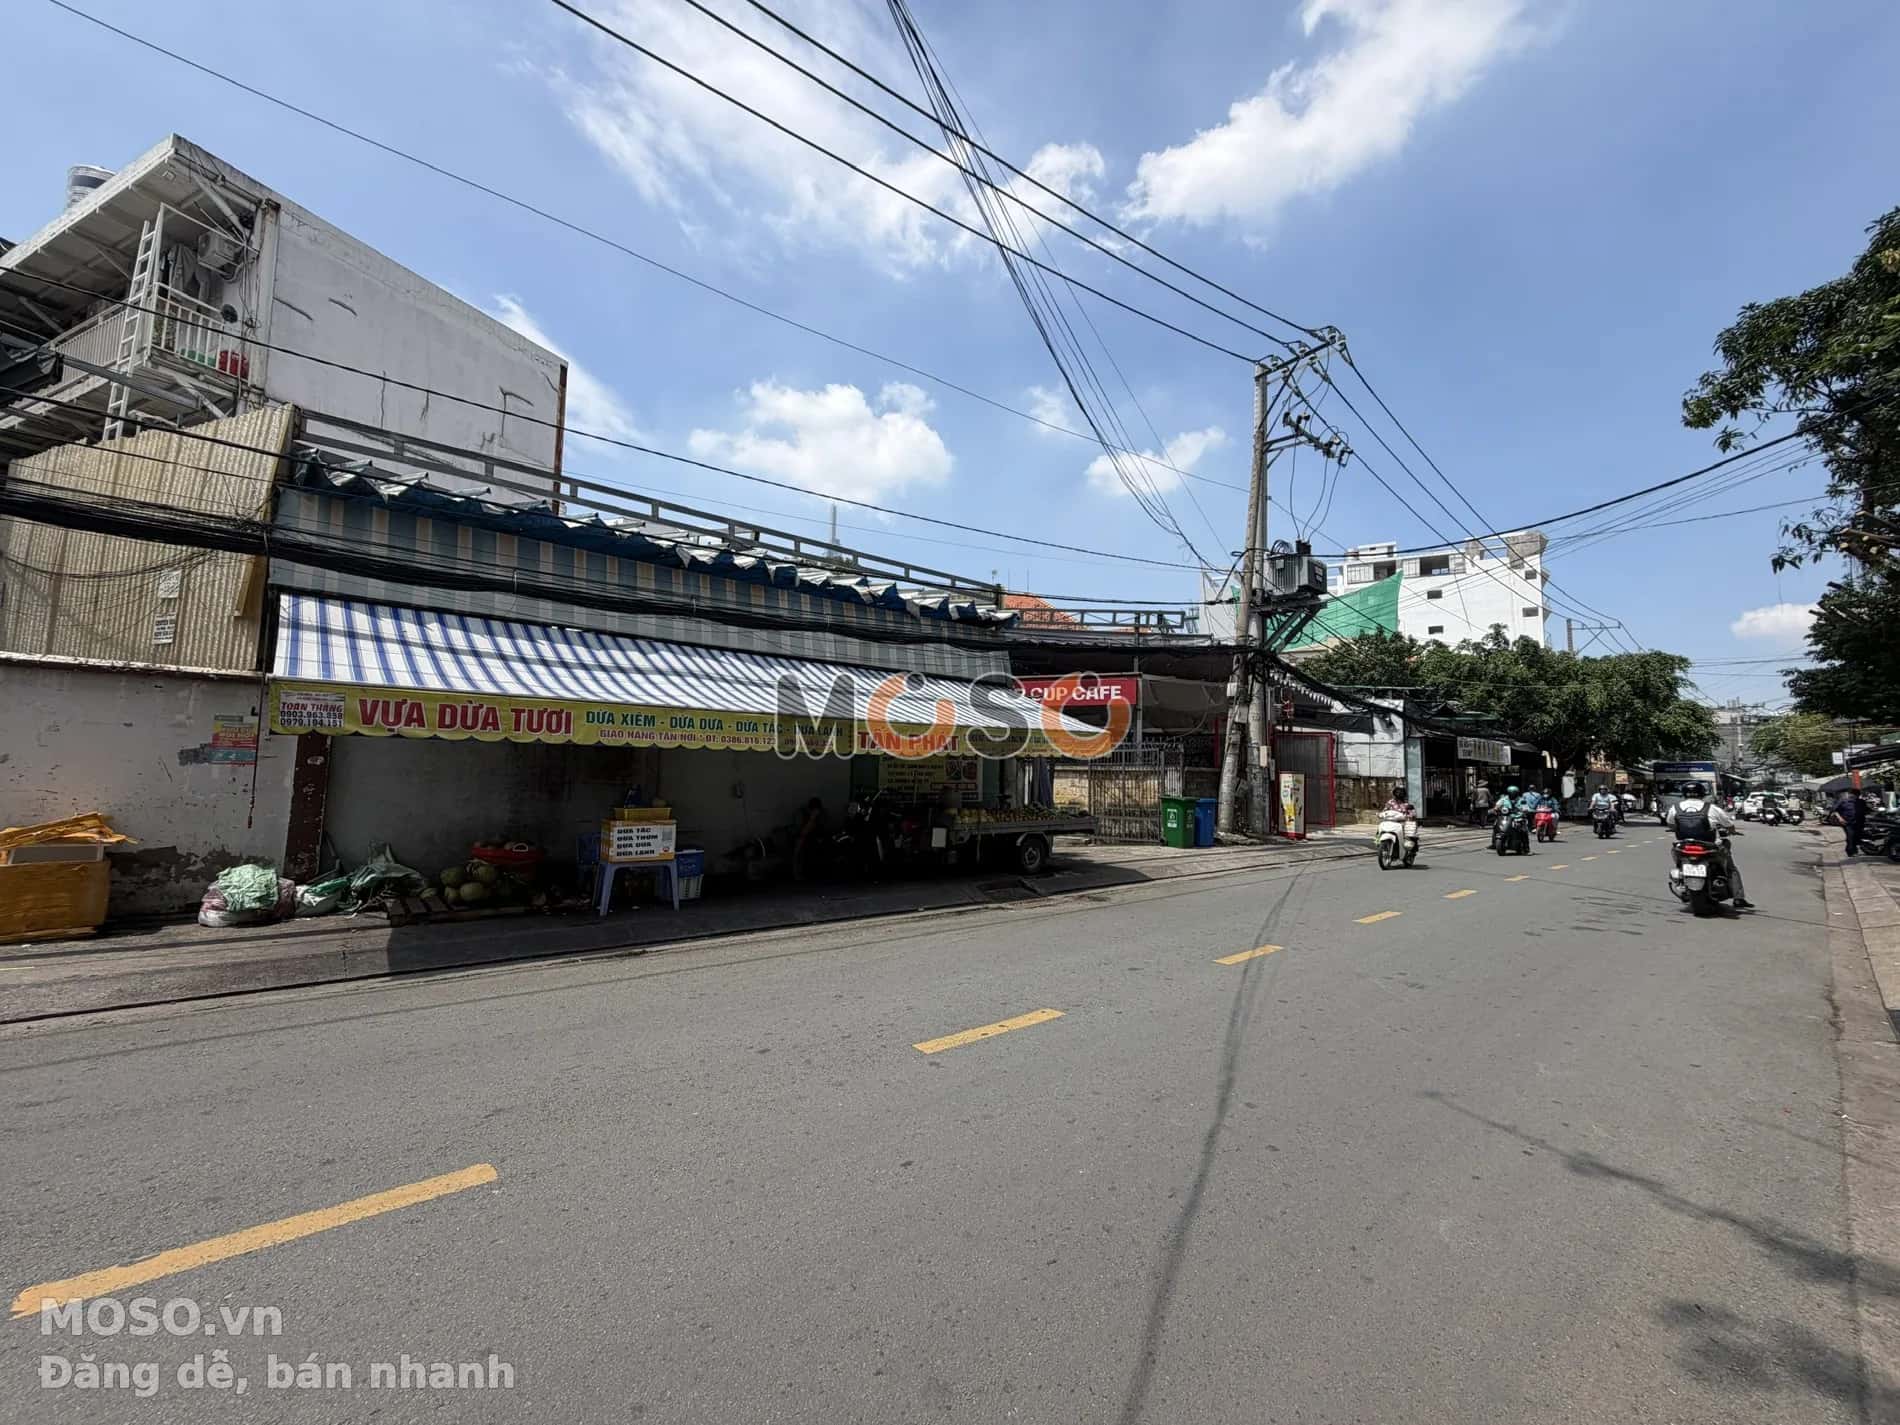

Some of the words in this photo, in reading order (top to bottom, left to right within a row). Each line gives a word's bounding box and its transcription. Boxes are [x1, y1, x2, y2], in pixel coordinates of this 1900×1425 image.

[1030, 686, 1068, 701] CUP
[1071, 684, 1122, 701] CAFE
[358, 698, 427, 732] VỰA
[437, 699, 501, 731] DỪA
[510, 706, 573, 735] TƯƠI
